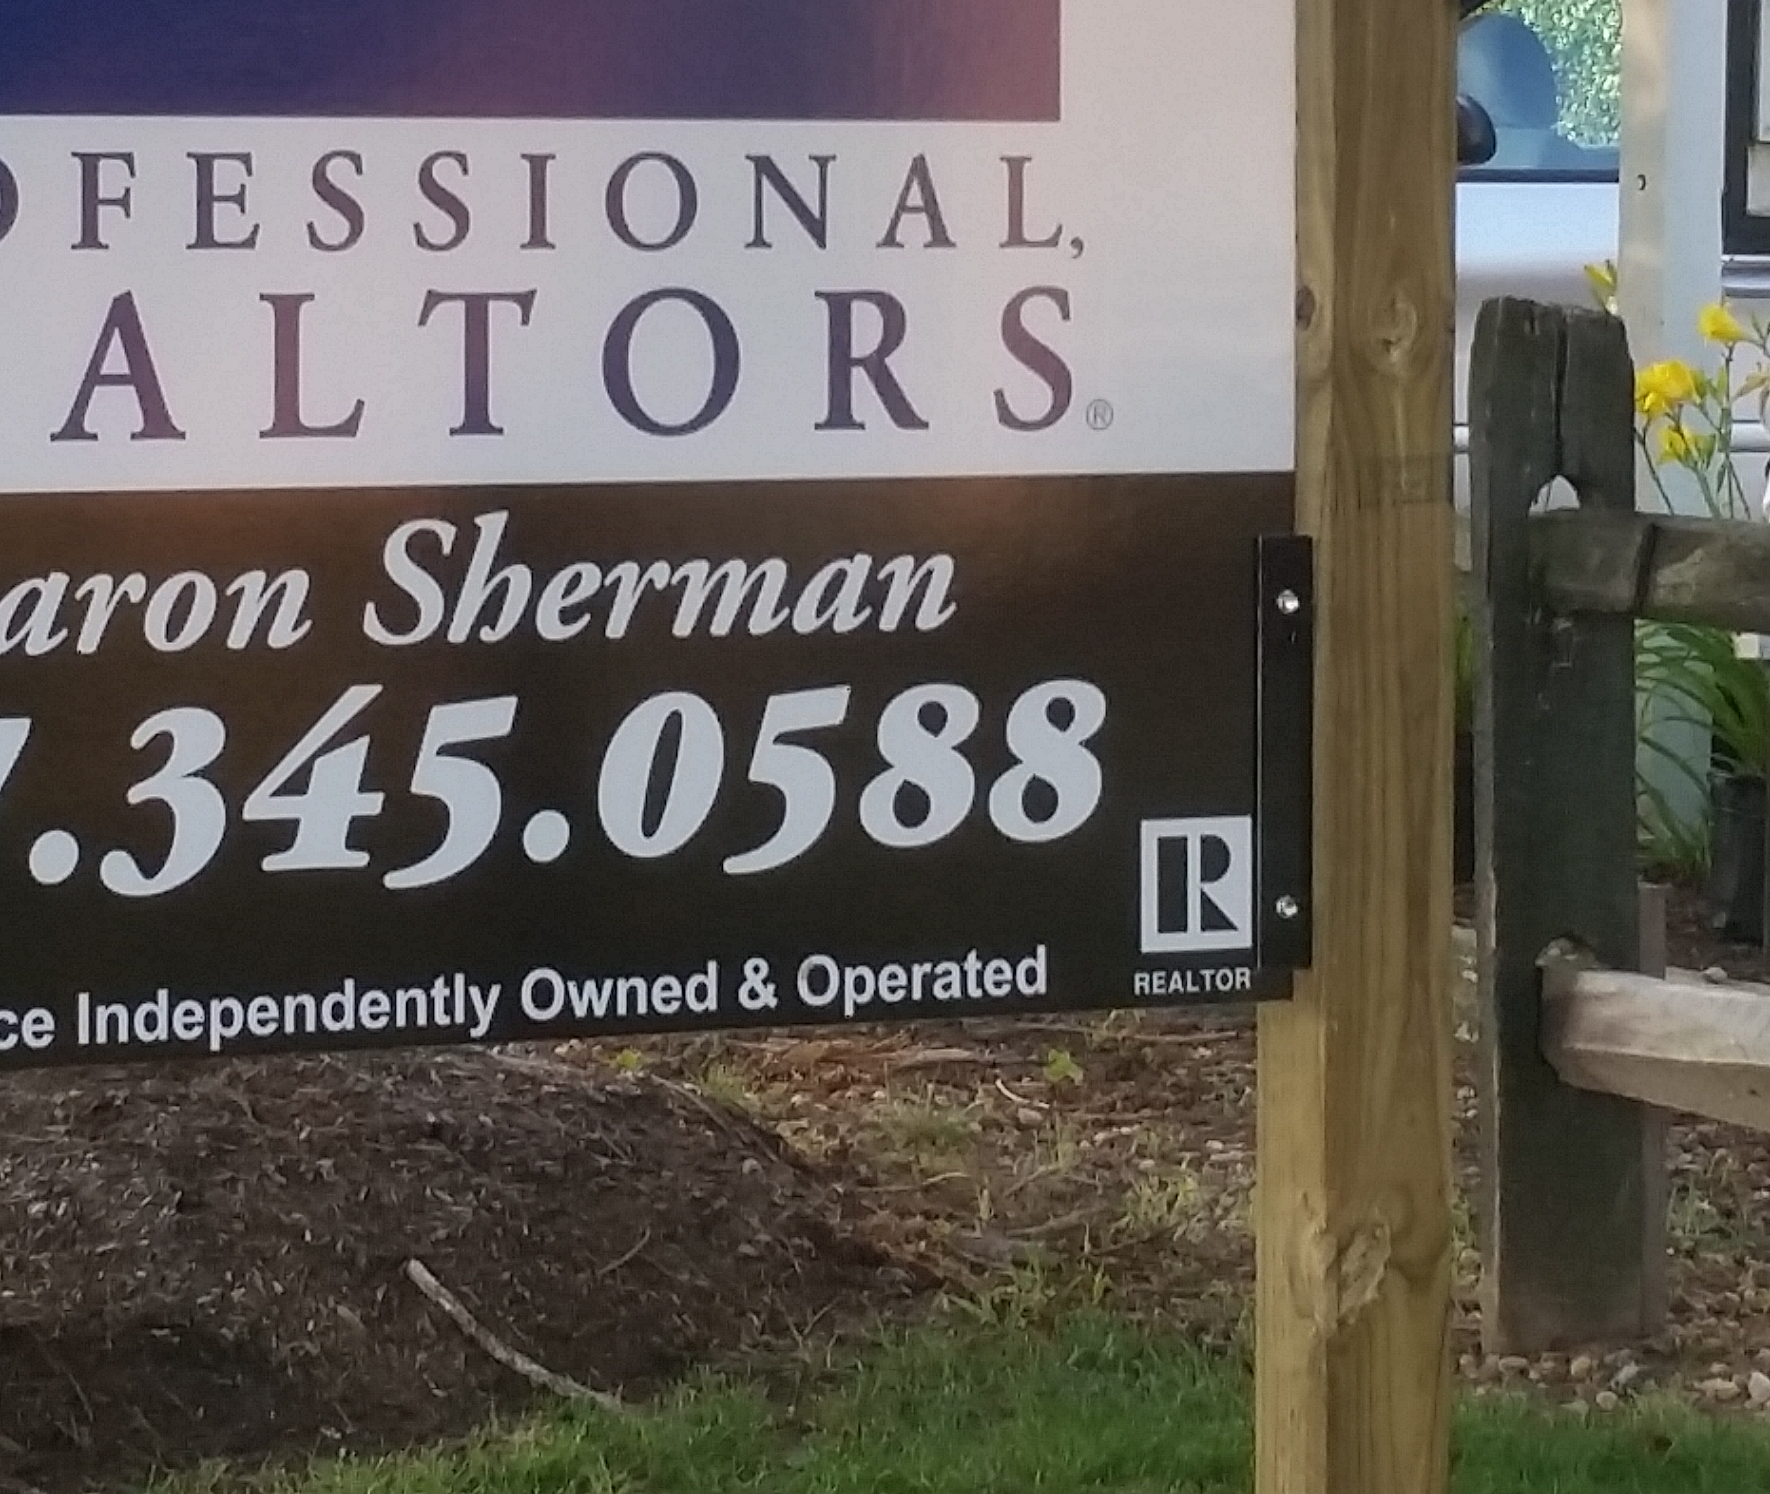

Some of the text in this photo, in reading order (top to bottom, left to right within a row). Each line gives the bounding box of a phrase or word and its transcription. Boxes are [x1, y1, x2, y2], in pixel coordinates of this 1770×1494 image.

[362, 510, 957, 646] Sherman
[77, 972, 502, 1050] Independently
[521, 960, 718, 1021] Owned
[738, 957, 778, 1010] &
[797, 944, 1047, 1017] Operated
[1134, 966, 1251, 996] REALTOR
